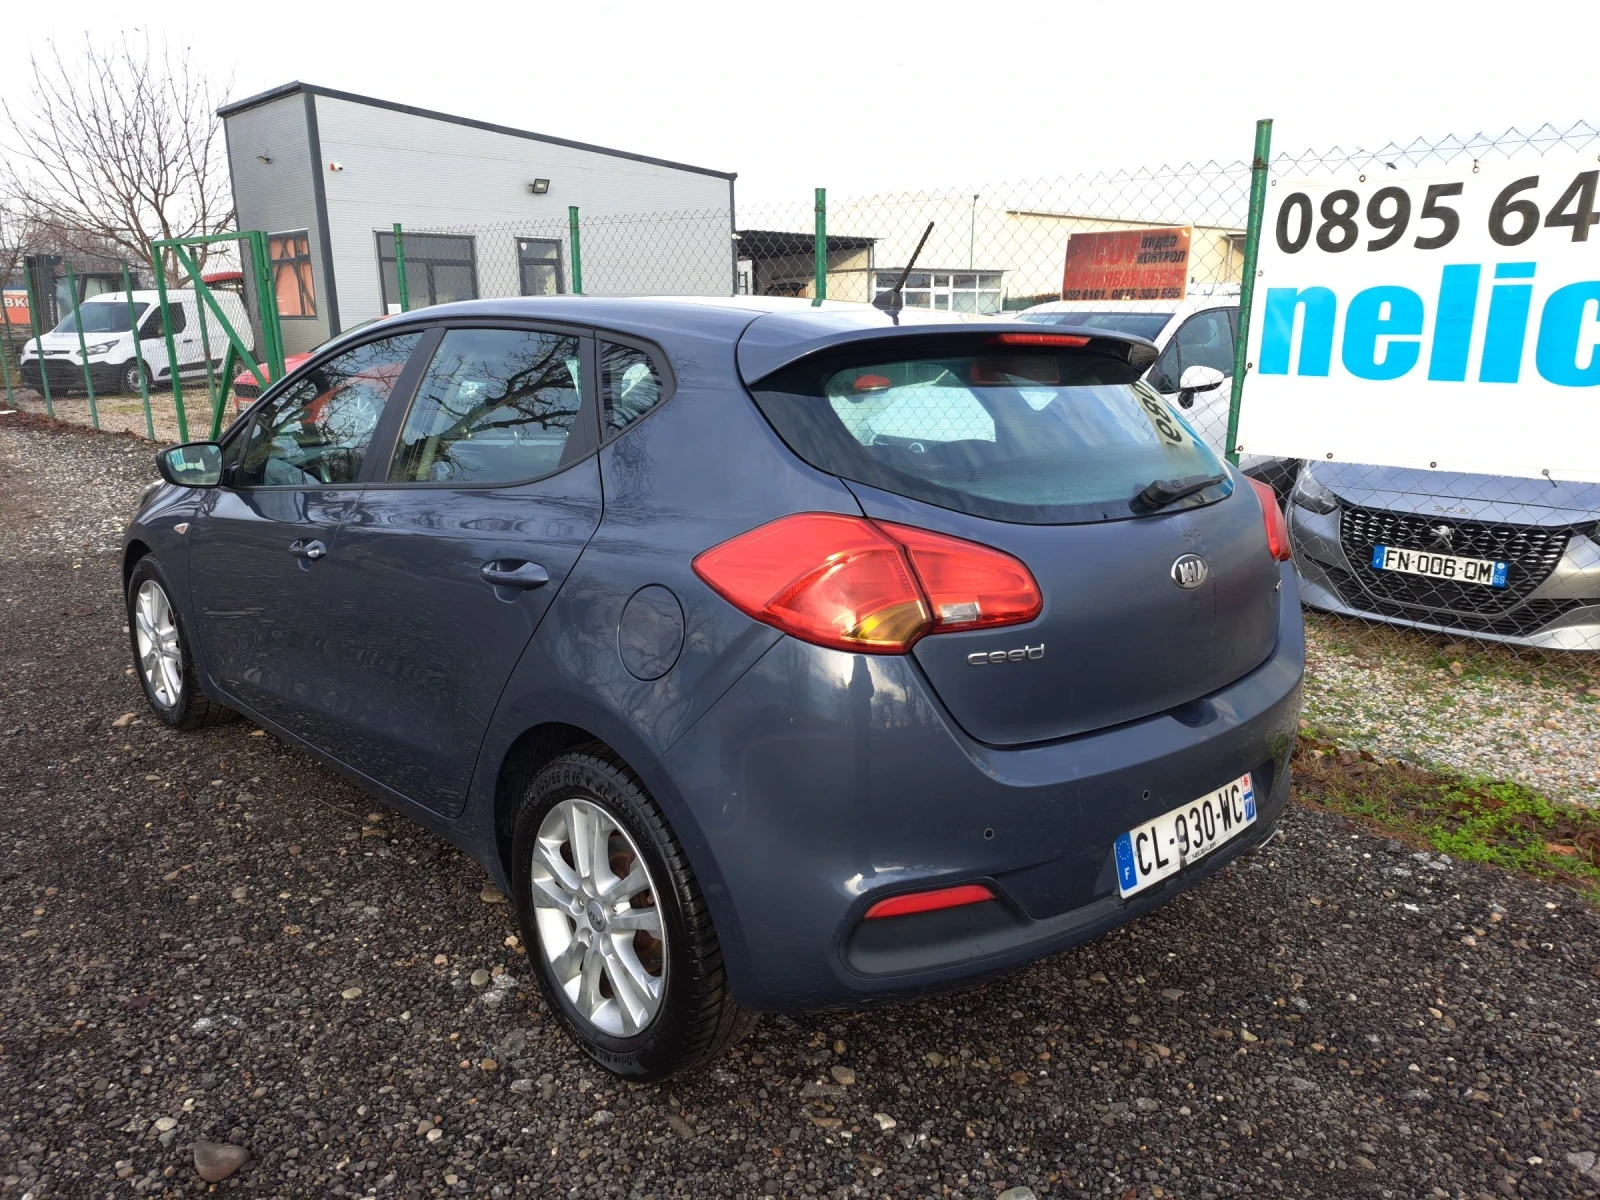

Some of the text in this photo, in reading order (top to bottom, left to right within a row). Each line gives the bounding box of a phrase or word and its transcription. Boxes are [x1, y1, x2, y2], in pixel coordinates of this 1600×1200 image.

[1141, 235, 1177, 250] ВИДЕО
[1275, 170, 1600, 254] 0895 64
[1137, 250, 1186, 264] КОНТРОЛ
[1258, 261, 1600, 387] nelic
[1124, 866, 1130, 880] F
[1135, 784, 1243, 876] CL-930-WC
